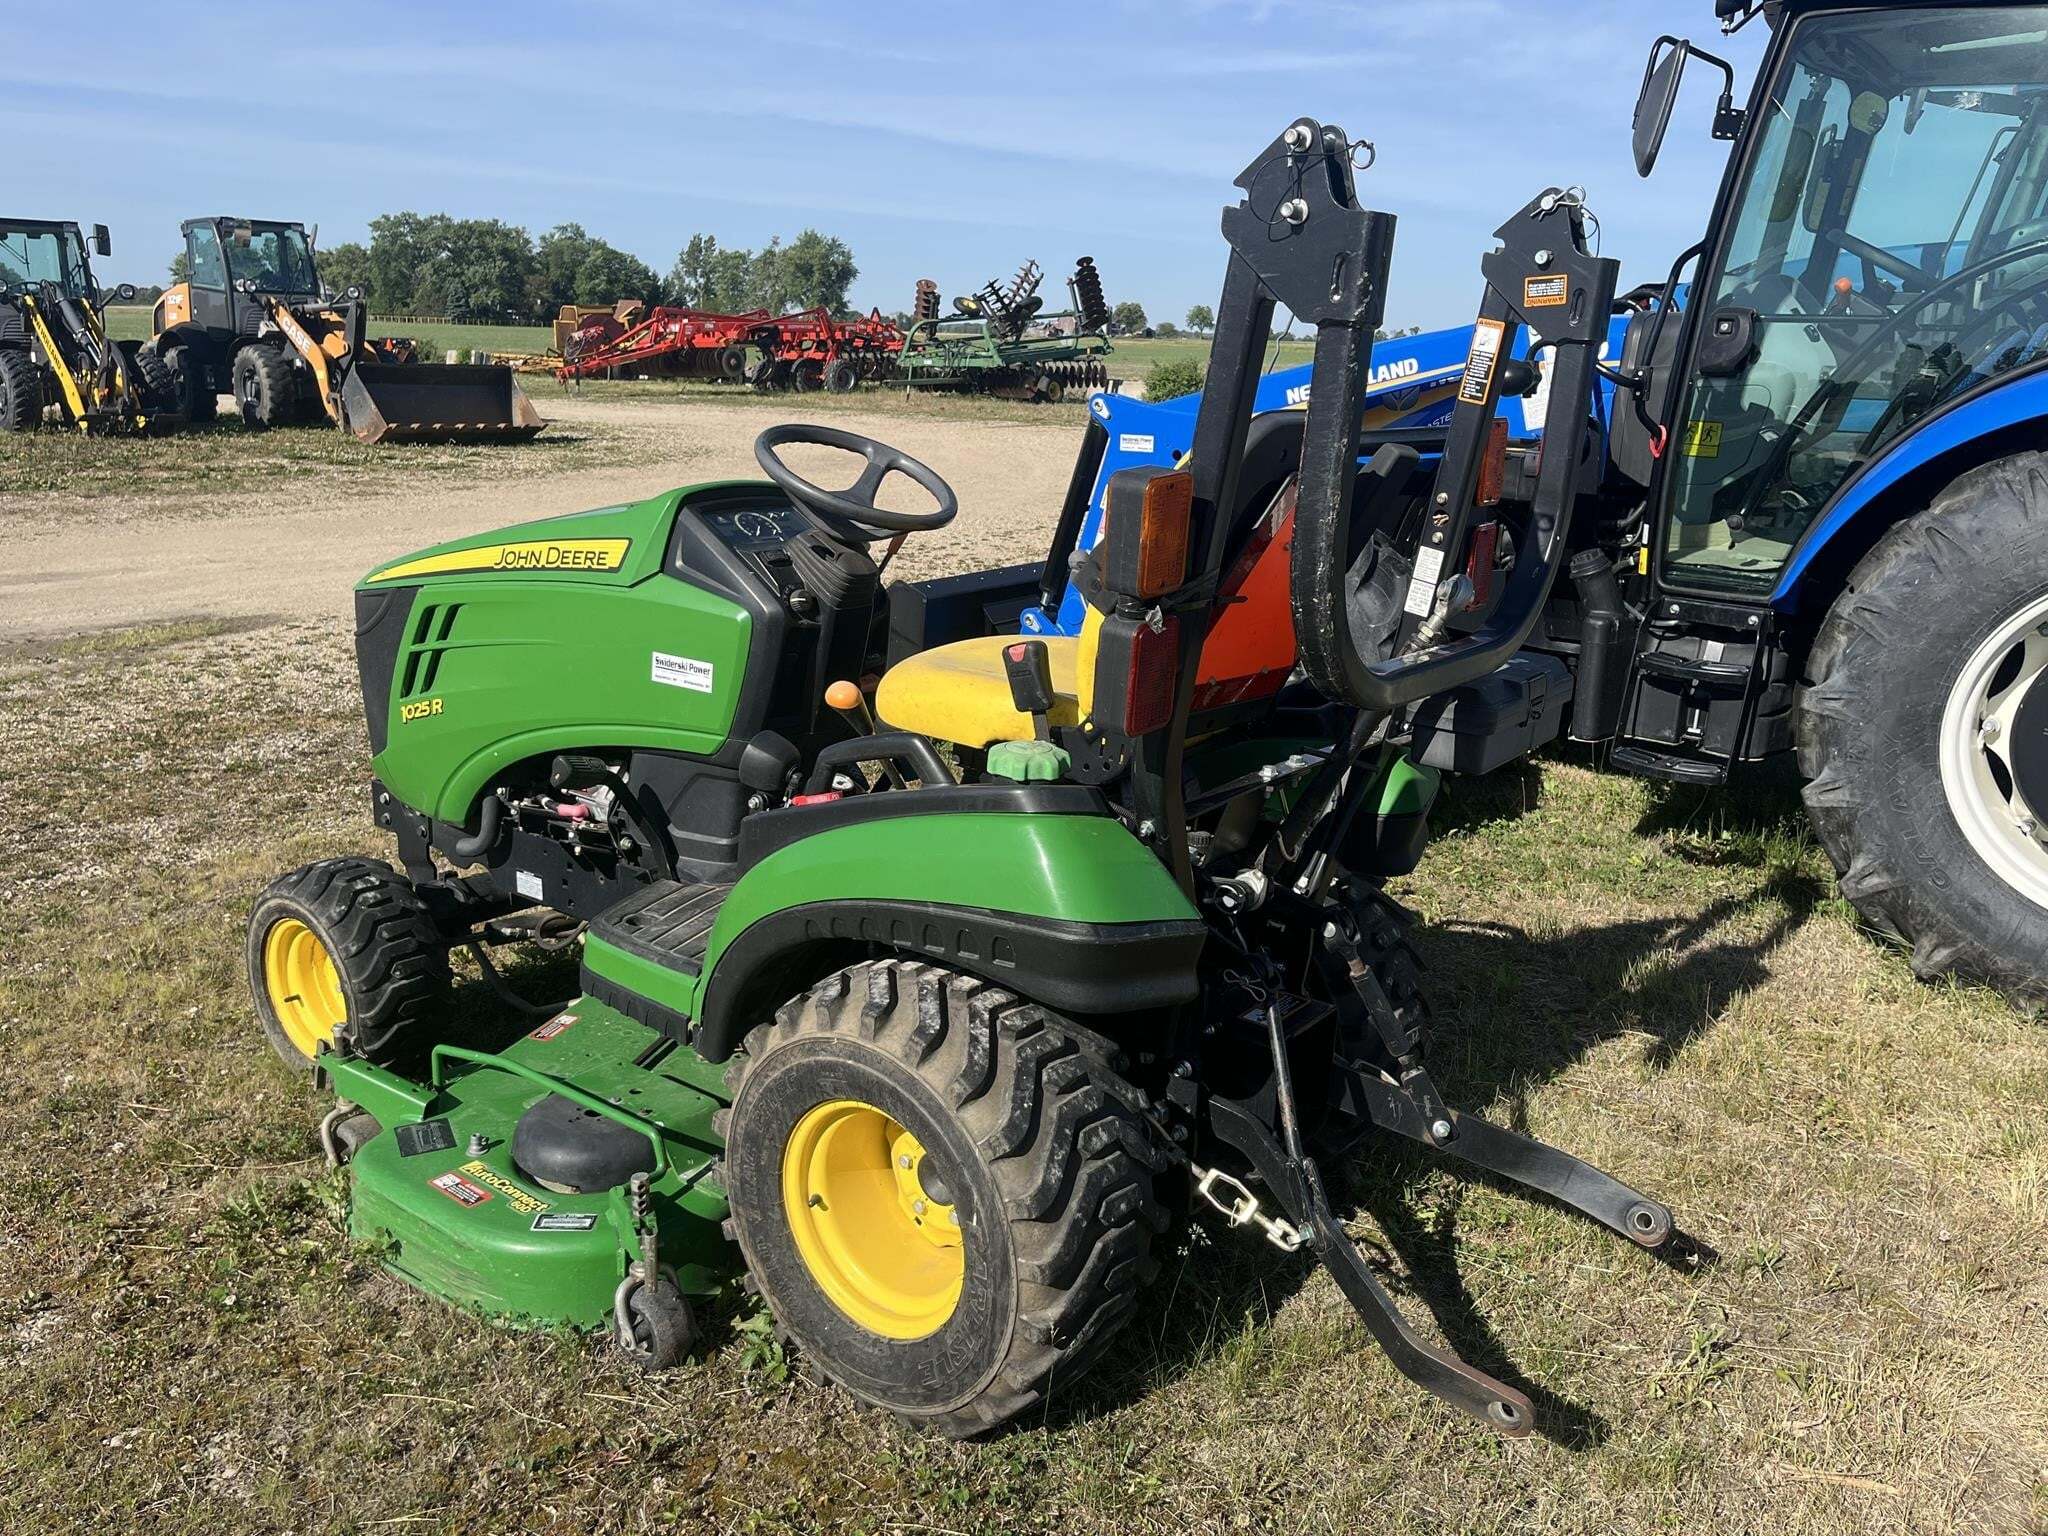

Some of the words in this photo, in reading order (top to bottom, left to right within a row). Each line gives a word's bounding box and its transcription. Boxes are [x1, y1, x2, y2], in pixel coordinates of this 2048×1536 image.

[282, 316, 310, 353] CASE
[494, 547, 543, 567] JOHN
[545, 546, 609, 567] DEERE
[655, 655, 688, 671] Swiderski
[689, 663, 711, 676] Power
[463, 1161, 549, 1212] AutoConnect
[510, 1200, 532, 1214] 60D
